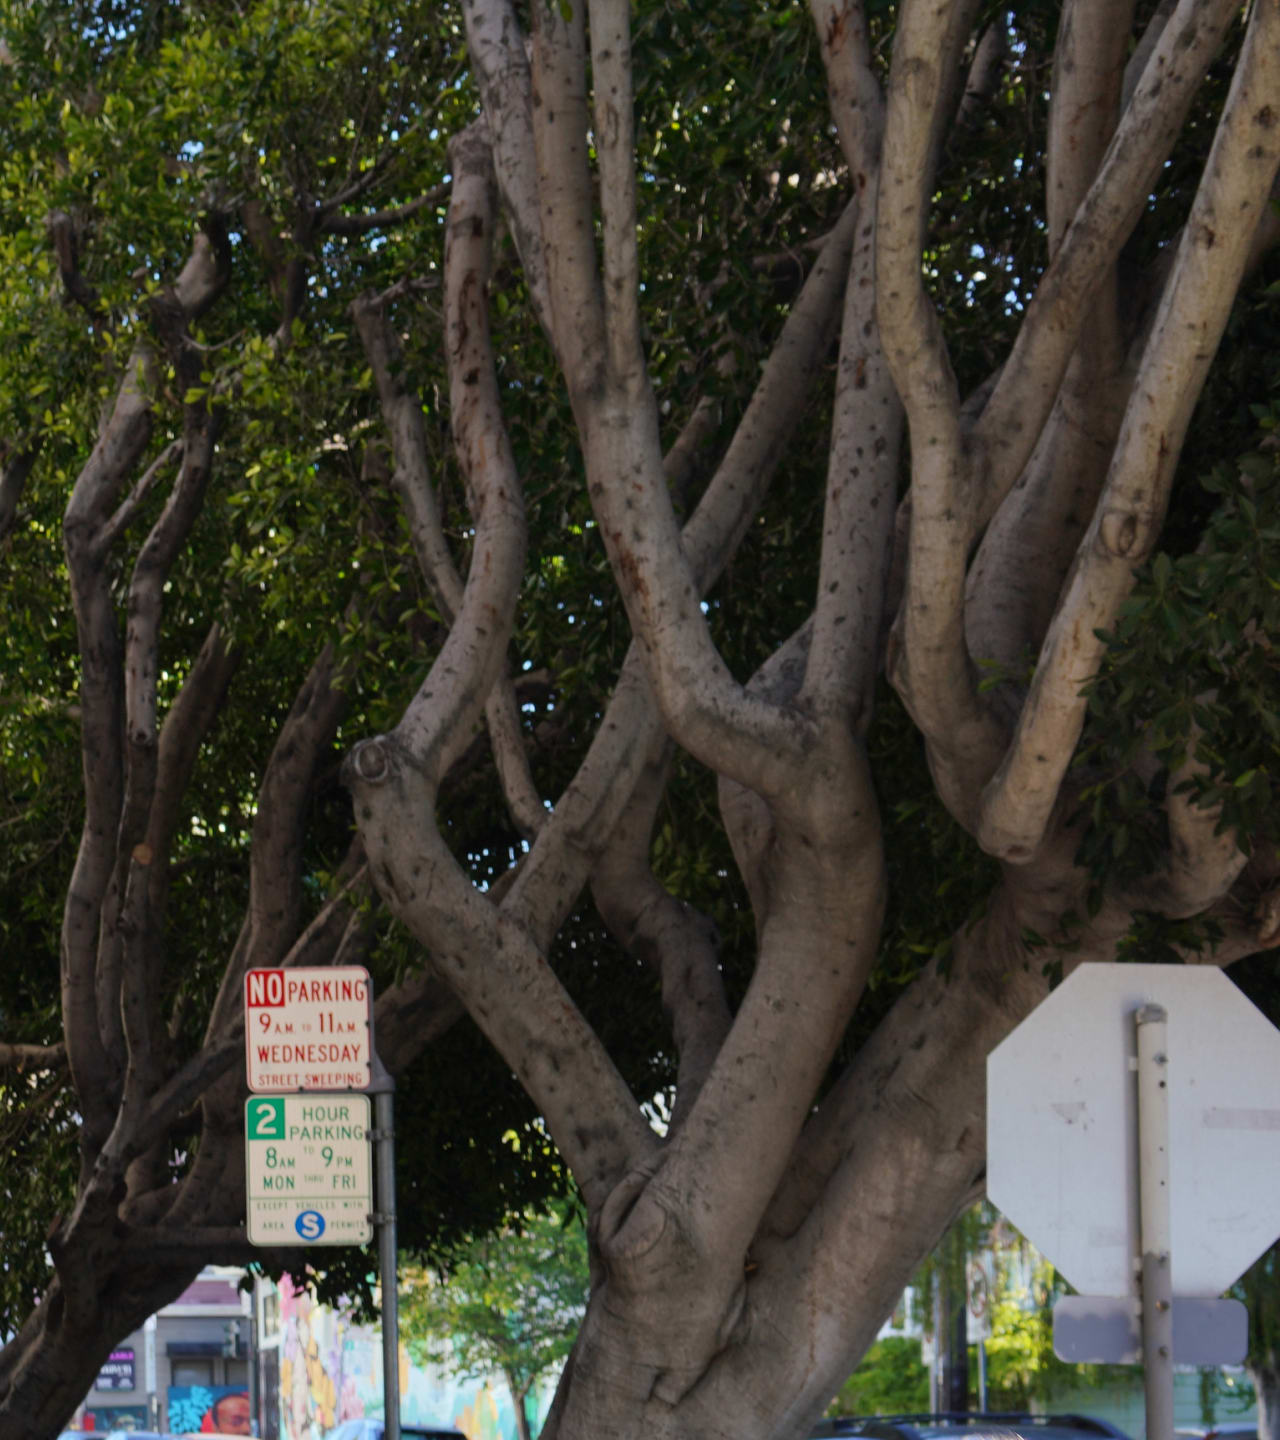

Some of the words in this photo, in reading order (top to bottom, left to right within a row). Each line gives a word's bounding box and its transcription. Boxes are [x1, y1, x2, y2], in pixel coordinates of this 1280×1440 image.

[249, 973, 282, 1006] NO
[288, 980, 365, 1002] PARKING
[257, 1043, 361, 1064] WEDNESDAY
[258, 1073, 300, 1087] STREET
[304, 1071, 363, 1087] SWEEPING
[255, 1103, 278, 1136] 2
[302, 1105, 350, 1122] HOUR
[289, 1125, 364, 1141] PARKING
[263, 1175, 296, 1191] MON
[332, 1174, 356, 1190] FRI
[256, 1201, 289, 1210] EXCEPT
[295, 1200, 336, 1210] VEHICLES
[343, 1200, 363, 1209] WITH
[263, 1221, 285, 1230] AREA
[301, 1212, 320, 1238] S
